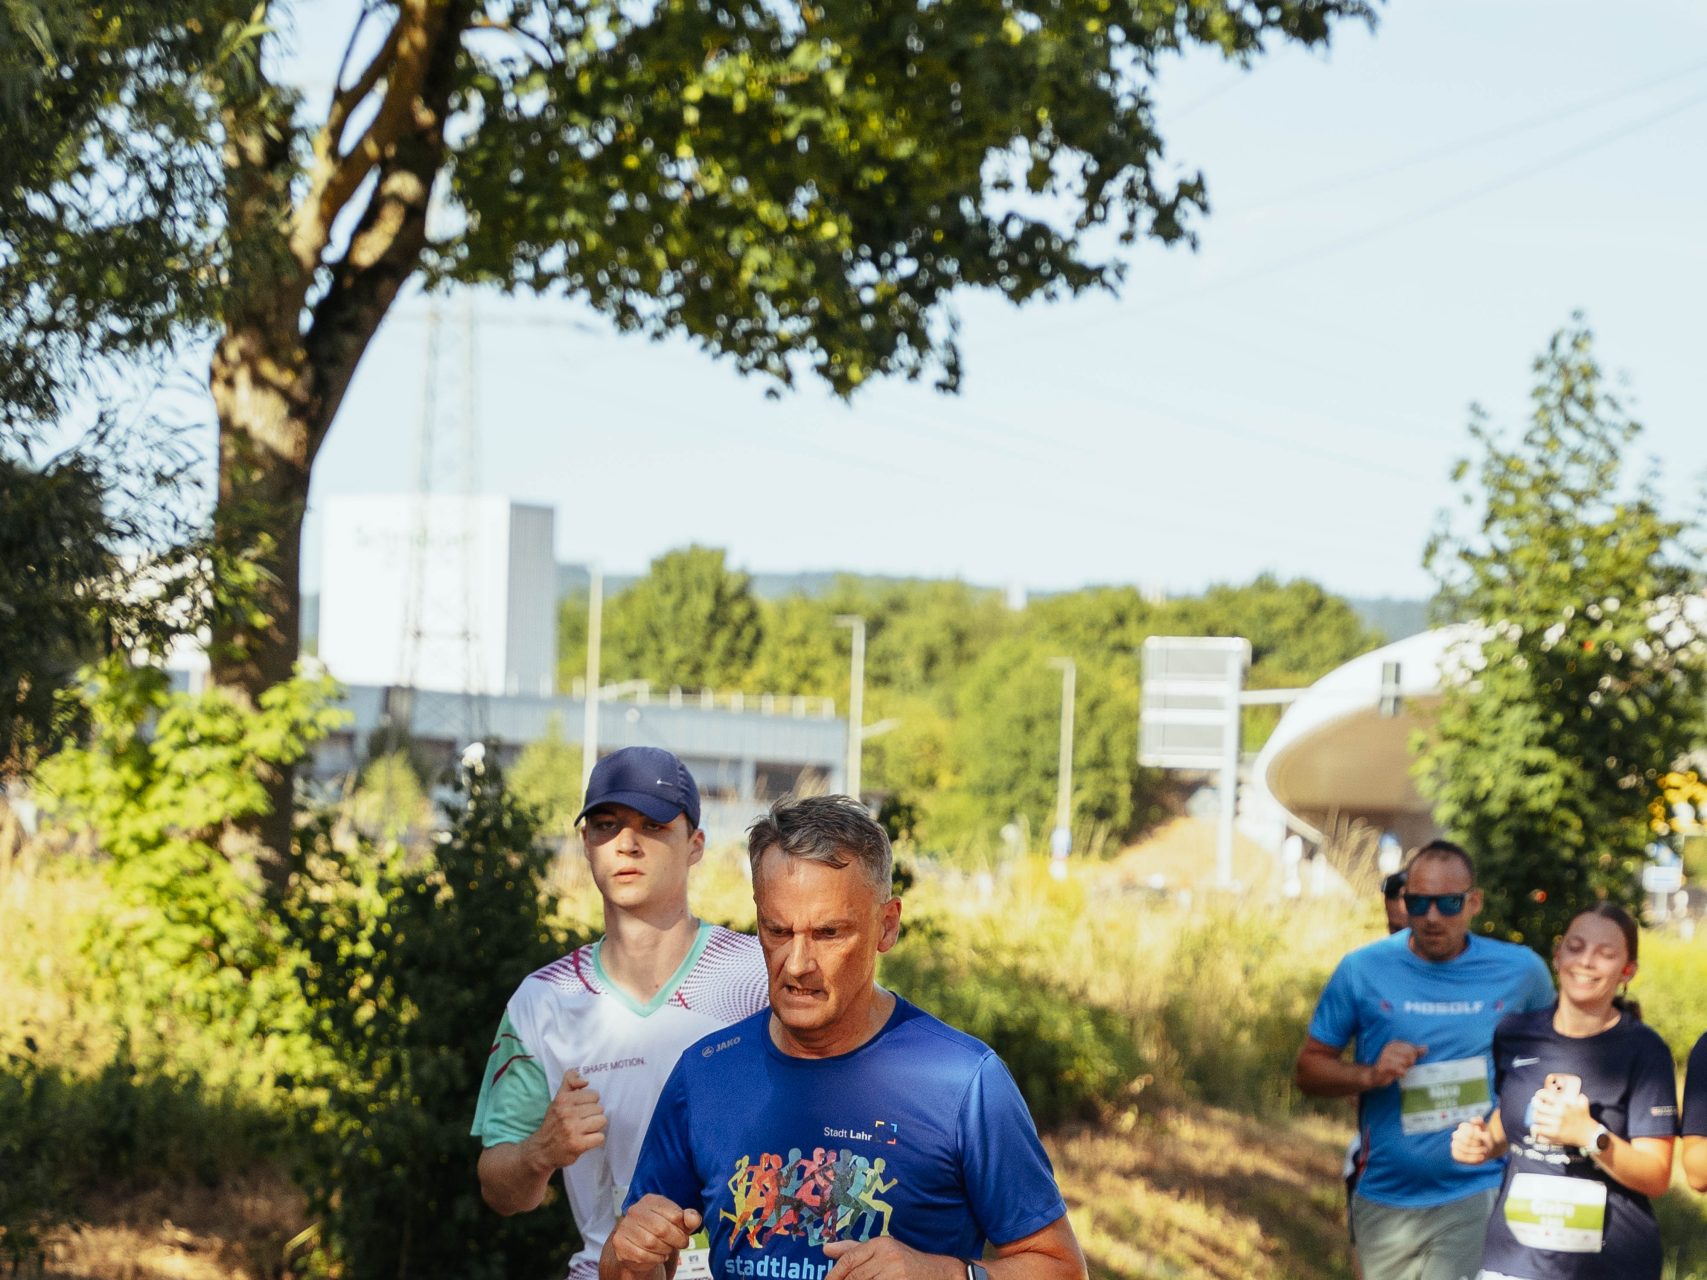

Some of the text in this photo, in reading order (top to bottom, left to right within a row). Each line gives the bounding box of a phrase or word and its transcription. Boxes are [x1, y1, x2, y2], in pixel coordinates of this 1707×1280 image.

[716, 1036, 741, 1052] JAKO
[582, 1062, 609, 1075] SHAPE
[824, 1126, 873, 1141] Stadt Lahr
